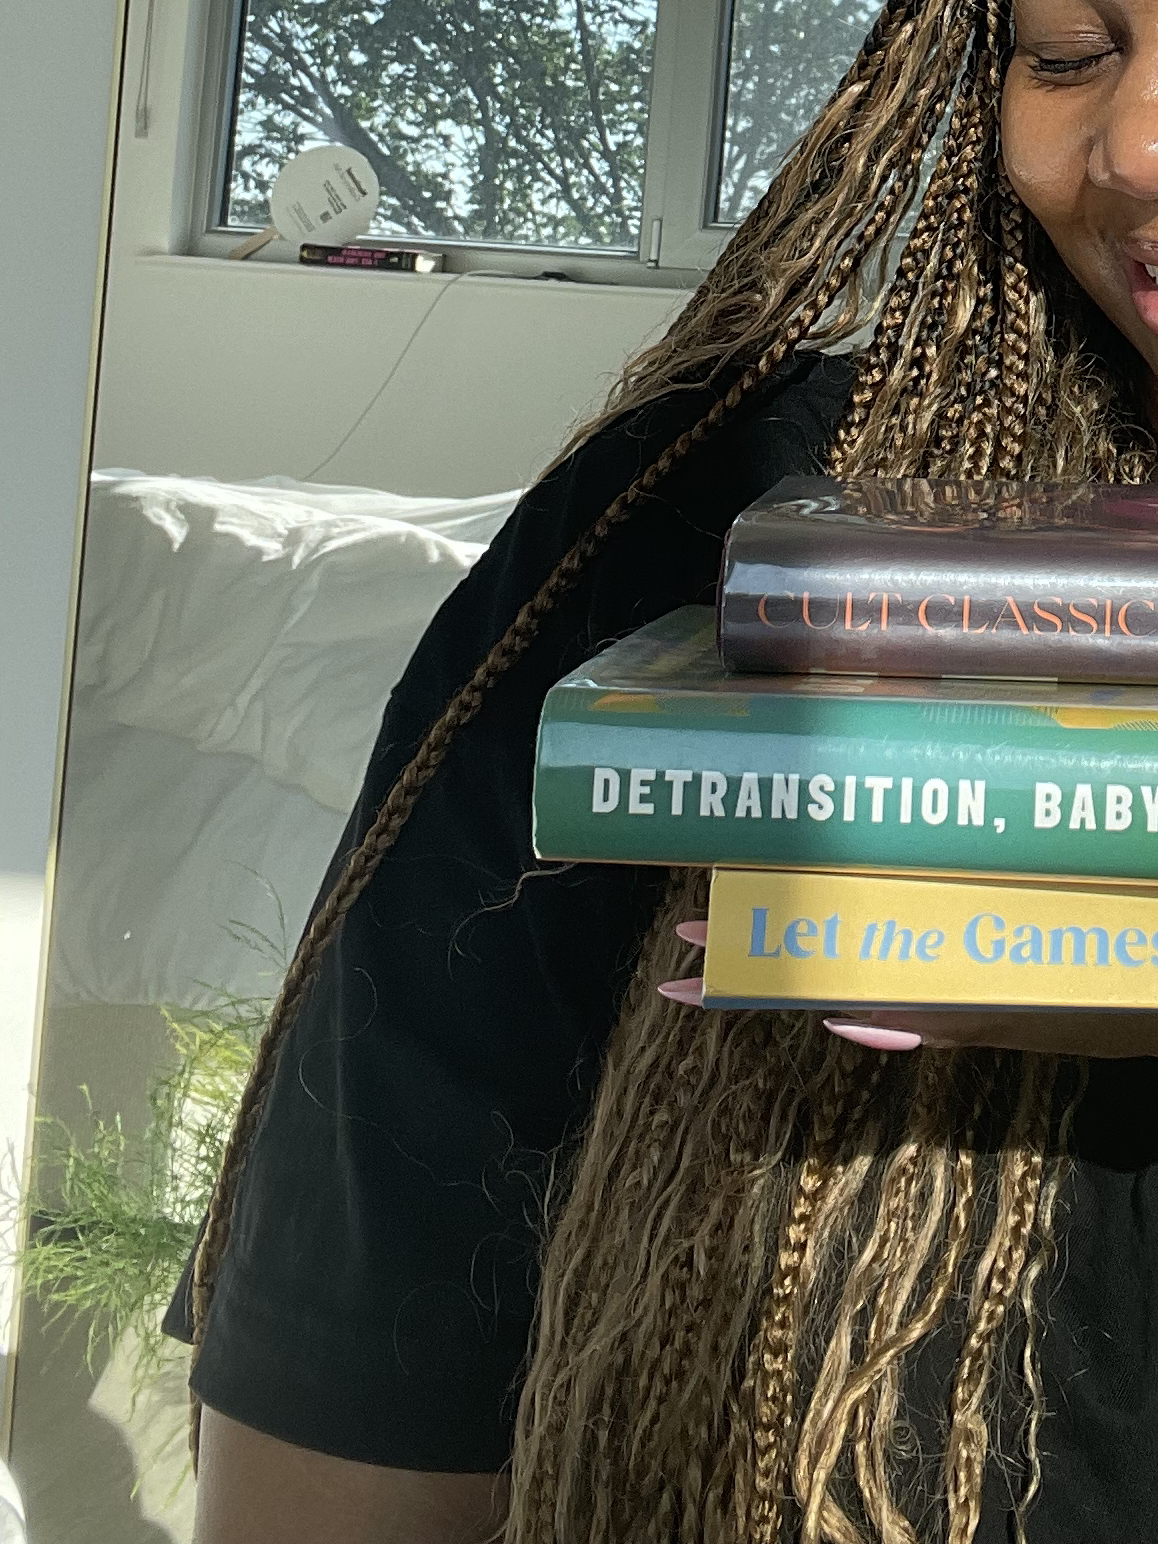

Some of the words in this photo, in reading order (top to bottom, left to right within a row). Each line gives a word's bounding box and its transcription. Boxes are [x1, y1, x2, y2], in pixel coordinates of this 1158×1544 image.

[756, 590, 903, 632] CULT
[917, 593, 1157, 639] CLASSIC
[591, 765, 1006, 834] DETRANSITION,
[748, 907, 842, 959] Let
[859, 918, 945, 962] the
